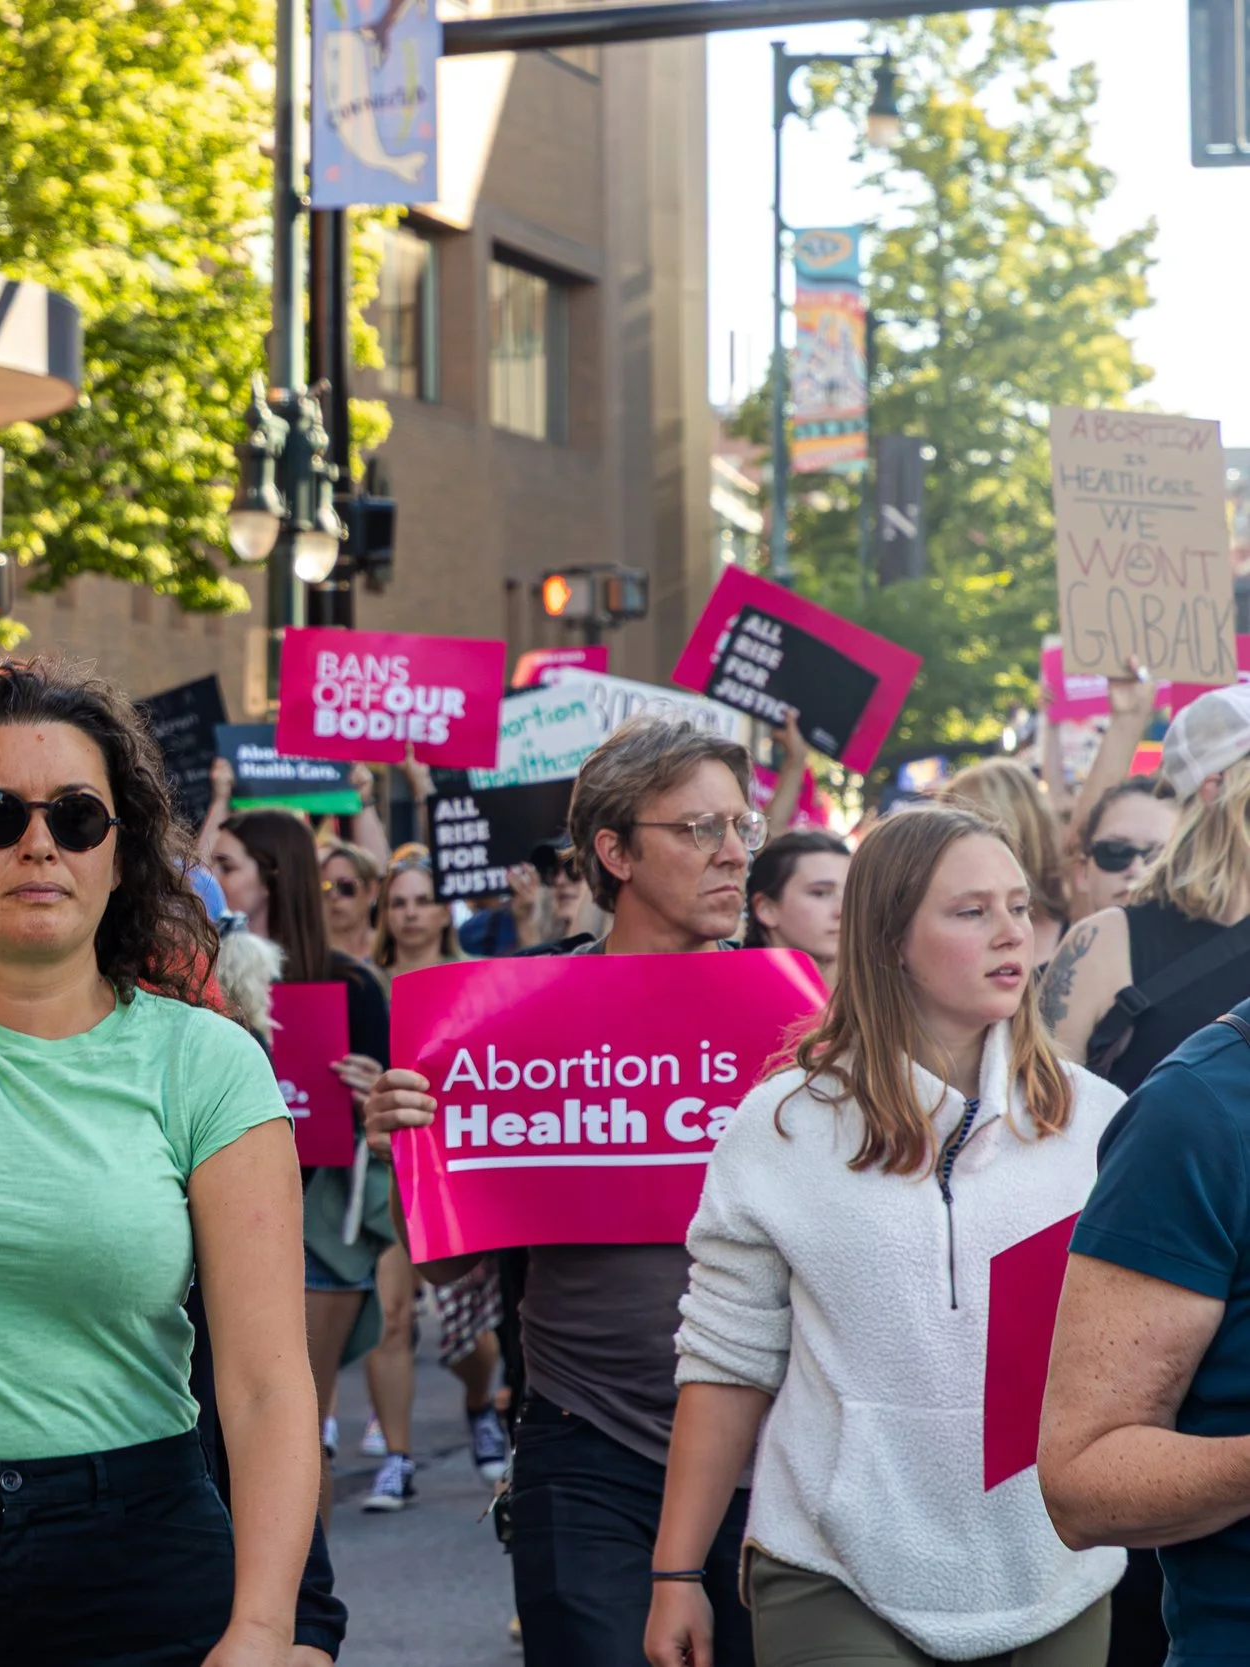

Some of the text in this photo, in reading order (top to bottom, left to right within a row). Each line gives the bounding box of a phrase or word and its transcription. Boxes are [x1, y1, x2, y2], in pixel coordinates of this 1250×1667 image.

[1069, 413, 1212, 453] ABORTION
[1099, 504, 1158, 540] WE
[742, 614, 782, 646] ALL
[316, 651, 410, 685] BANS
[733, 633, 784, 671] RISE
[723, 655, 769, 689] FOR
[312, 680, 466, 719] OFF OUR
[314, 707, 450, 745] BODIES
[502, 703, 586, 737] ortion
[434, 796, 480, 821] ALL
[437, 819, 490, 846] RISE
[439, 845, 488, 871] FOR
[440, 866, 509, 896] JUSTI
[442, 1040, 738, 1092] Abortion is
[444, 1096, 737, 1148] Health Ca
